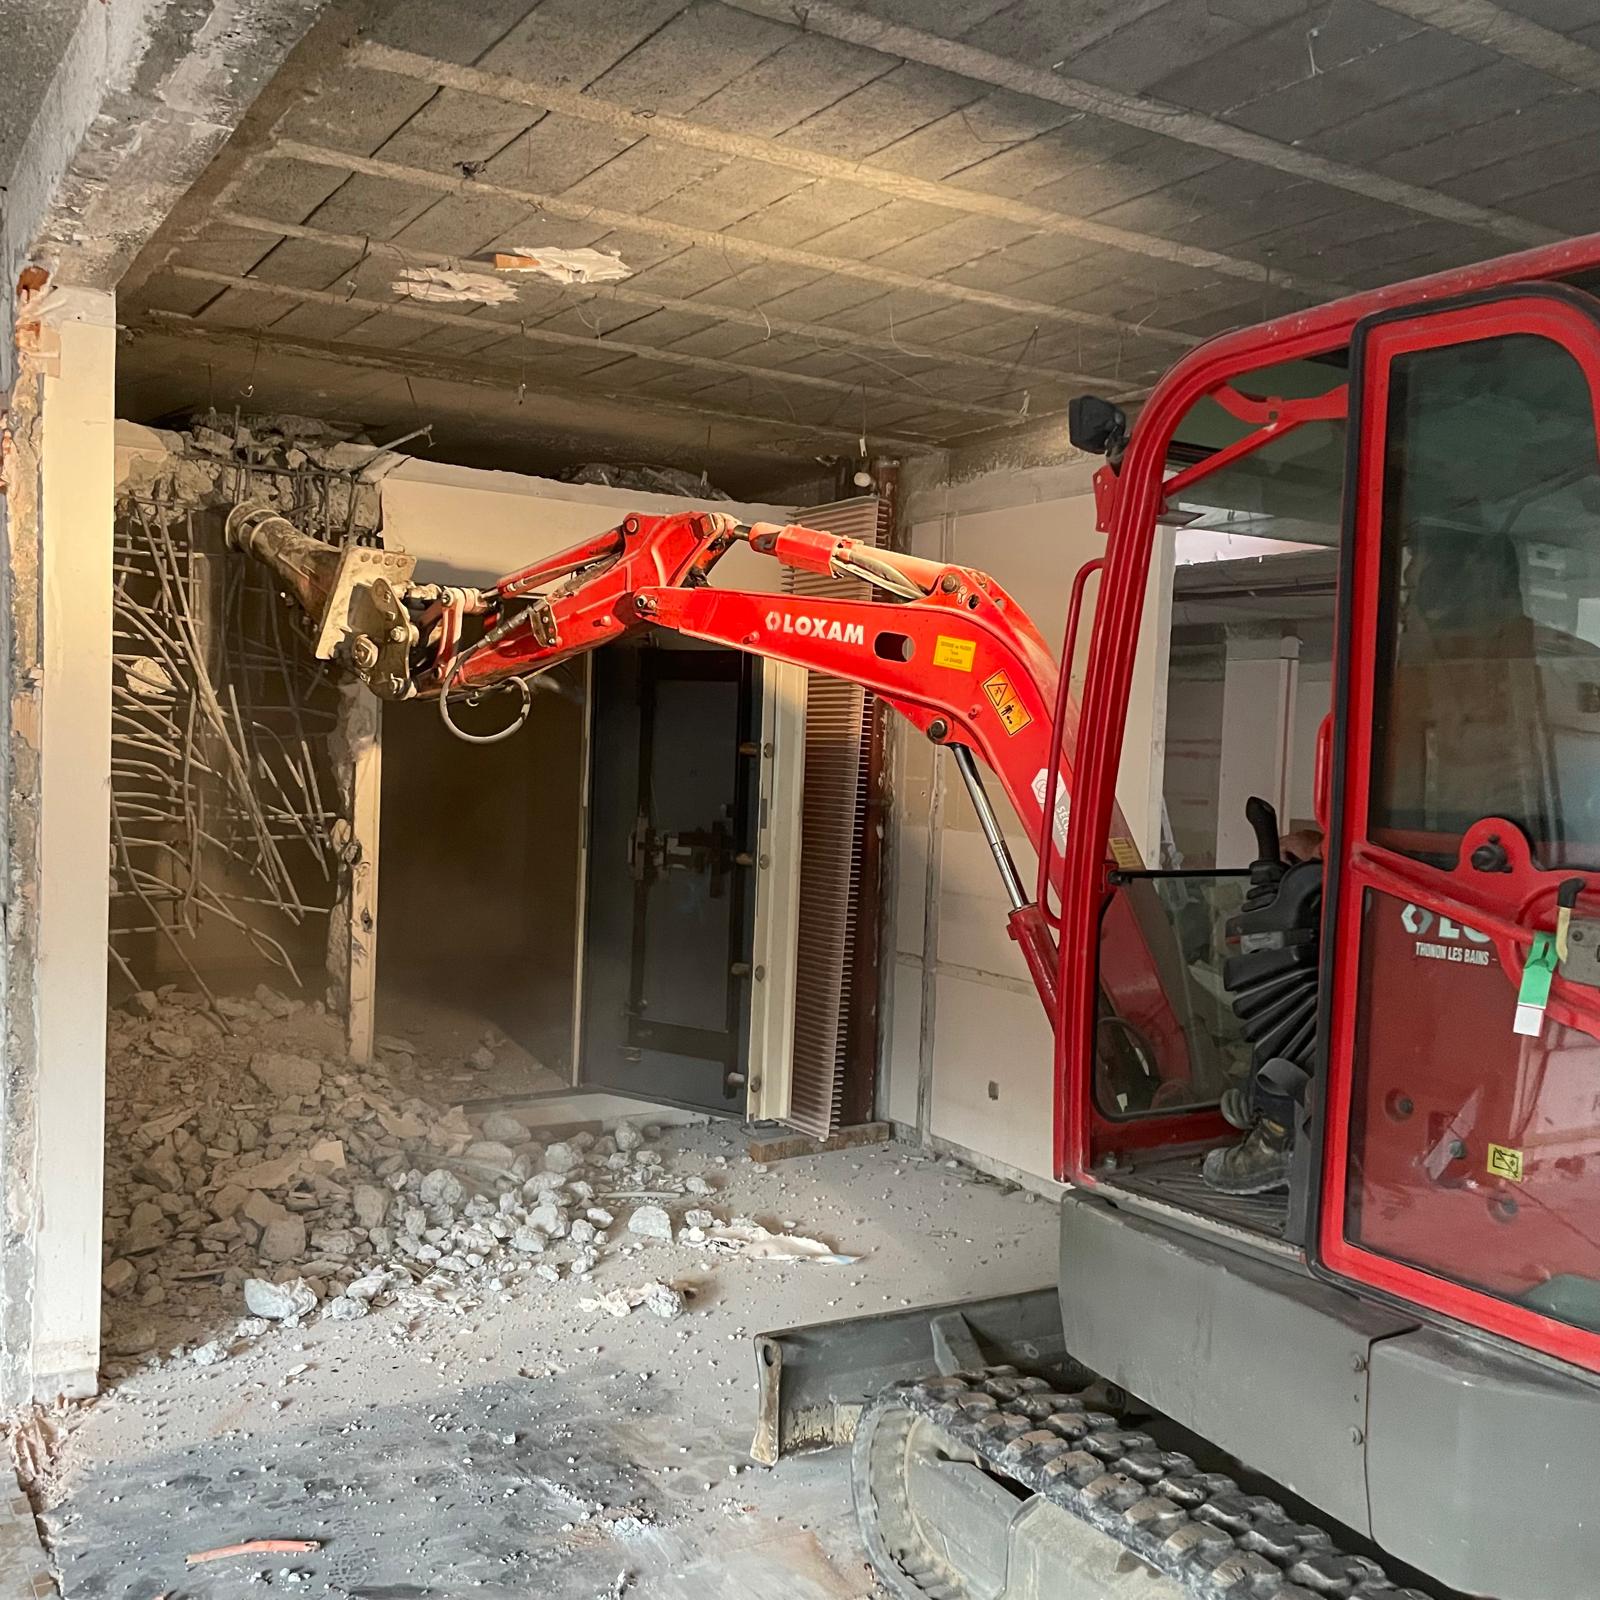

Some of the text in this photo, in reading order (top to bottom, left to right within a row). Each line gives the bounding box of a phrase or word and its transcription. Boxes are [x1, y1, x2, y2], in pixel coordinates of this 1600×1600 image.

[783, 613, 864, 645] LOXAM
[1416, 942, 1447, 959] THONON
[1448, 946, 1463, 962] LES
[1464, 949, 1489, 966] BAINS
